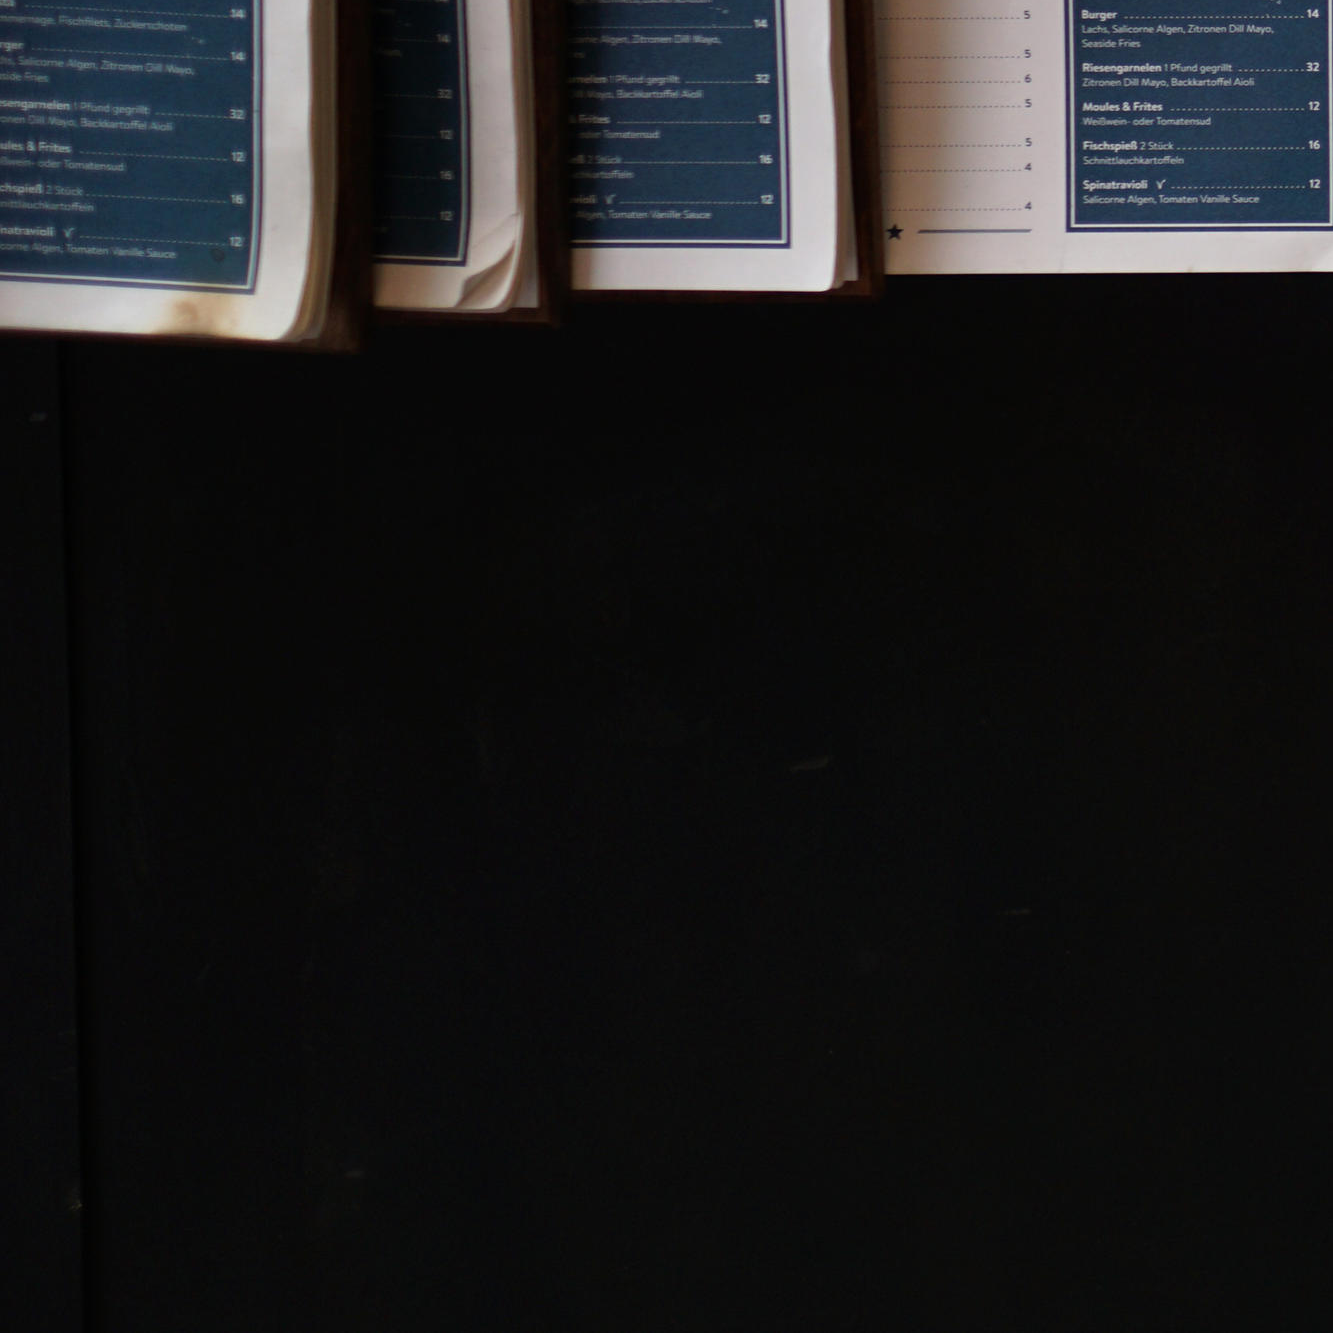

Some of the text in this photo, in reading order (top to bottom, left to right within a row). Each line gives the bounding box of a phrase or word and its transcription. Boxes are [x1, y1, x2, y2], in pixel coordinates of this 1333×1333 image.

[1024, 10, 1031, 19] 5
[1081, 9, 1319, 22] Burger 14
[1082, 24, 1274, 37] Lachs, Salicorne Algen, Zitronen Dill Mayo,
[1081, 38, 1141, 49] Seaside Fries
[231, 52, 246, 62] 14
[1024, 49, 1032, 59] 5
[1082, 63, 1162, 75] Riesengarnelen
[1170, 63, 1198, 73] Pfund
[1199, 63, 1233, 75] gegrillt
[1305, 62, 1320, 72] 32
[1025, 74, 1032, 83] 6
[1081, 77, 1255, 90] Zitronen Dill Mayo, Backkartoffel Aioli
[1025, 99, 1032, 108] 5
[1082, 101, 1320, 112] Moules & Frites 12
[229, 109, 245, 119] 32
[1132, 116, 1154, 126] oder
[1156, 116, 1212, 126] Tomatensud
[1026, 137, 1033, 147] 5
[1082, 140, 1320, 153] Fischspieß 2 Stück 16
[232, 152, 246, 162] 12
[1083, 155, 1185, 166] Schnittlauchkartoffeln
[1025, 163, 1032, 172] 4
[1082, 179, 1321, 192] Spinatravioli 12
[231, 195, 245, 205] 16
[1083, 194, 1260, 207] Salicorne Algen, Tomaten Vanille Sauce
[1025, 201, 1032, 211] 4
[230, 237, 244, 247] 12
